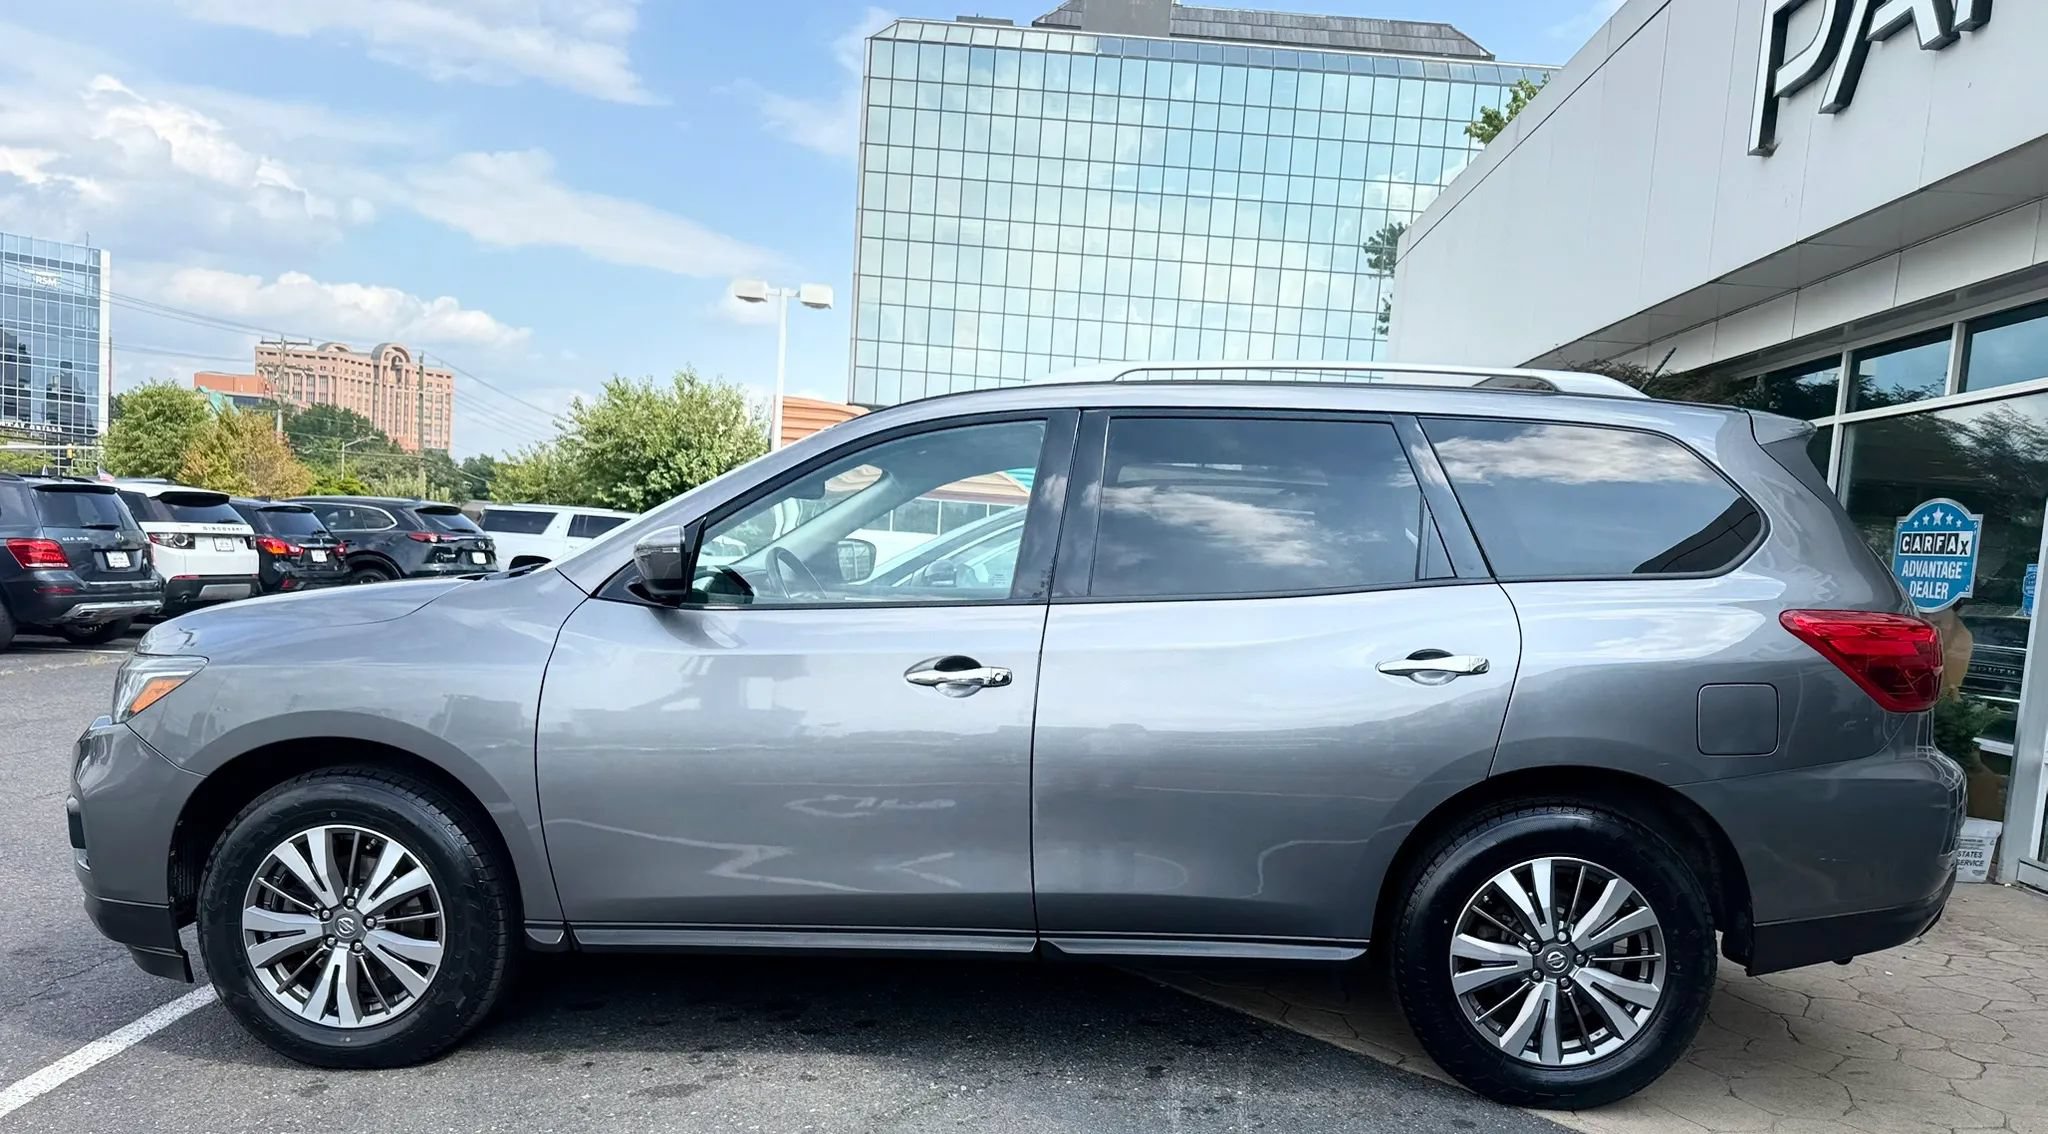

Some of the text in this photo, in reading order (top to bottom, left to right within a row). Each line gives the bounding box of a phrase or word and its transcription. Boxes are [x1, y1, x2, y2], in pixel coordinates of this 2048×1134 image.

[1747, 0, 1993, 156] PA
[1902, 534, 1969, 555] CARFAX
[1901, 560, 1962, 579] ADVANTAGE
[1909, 580, 1949, 600] DEALER
[1956, 859, 1985, 867] SERVICE
[1957, 850, 1983, 859] STATES
